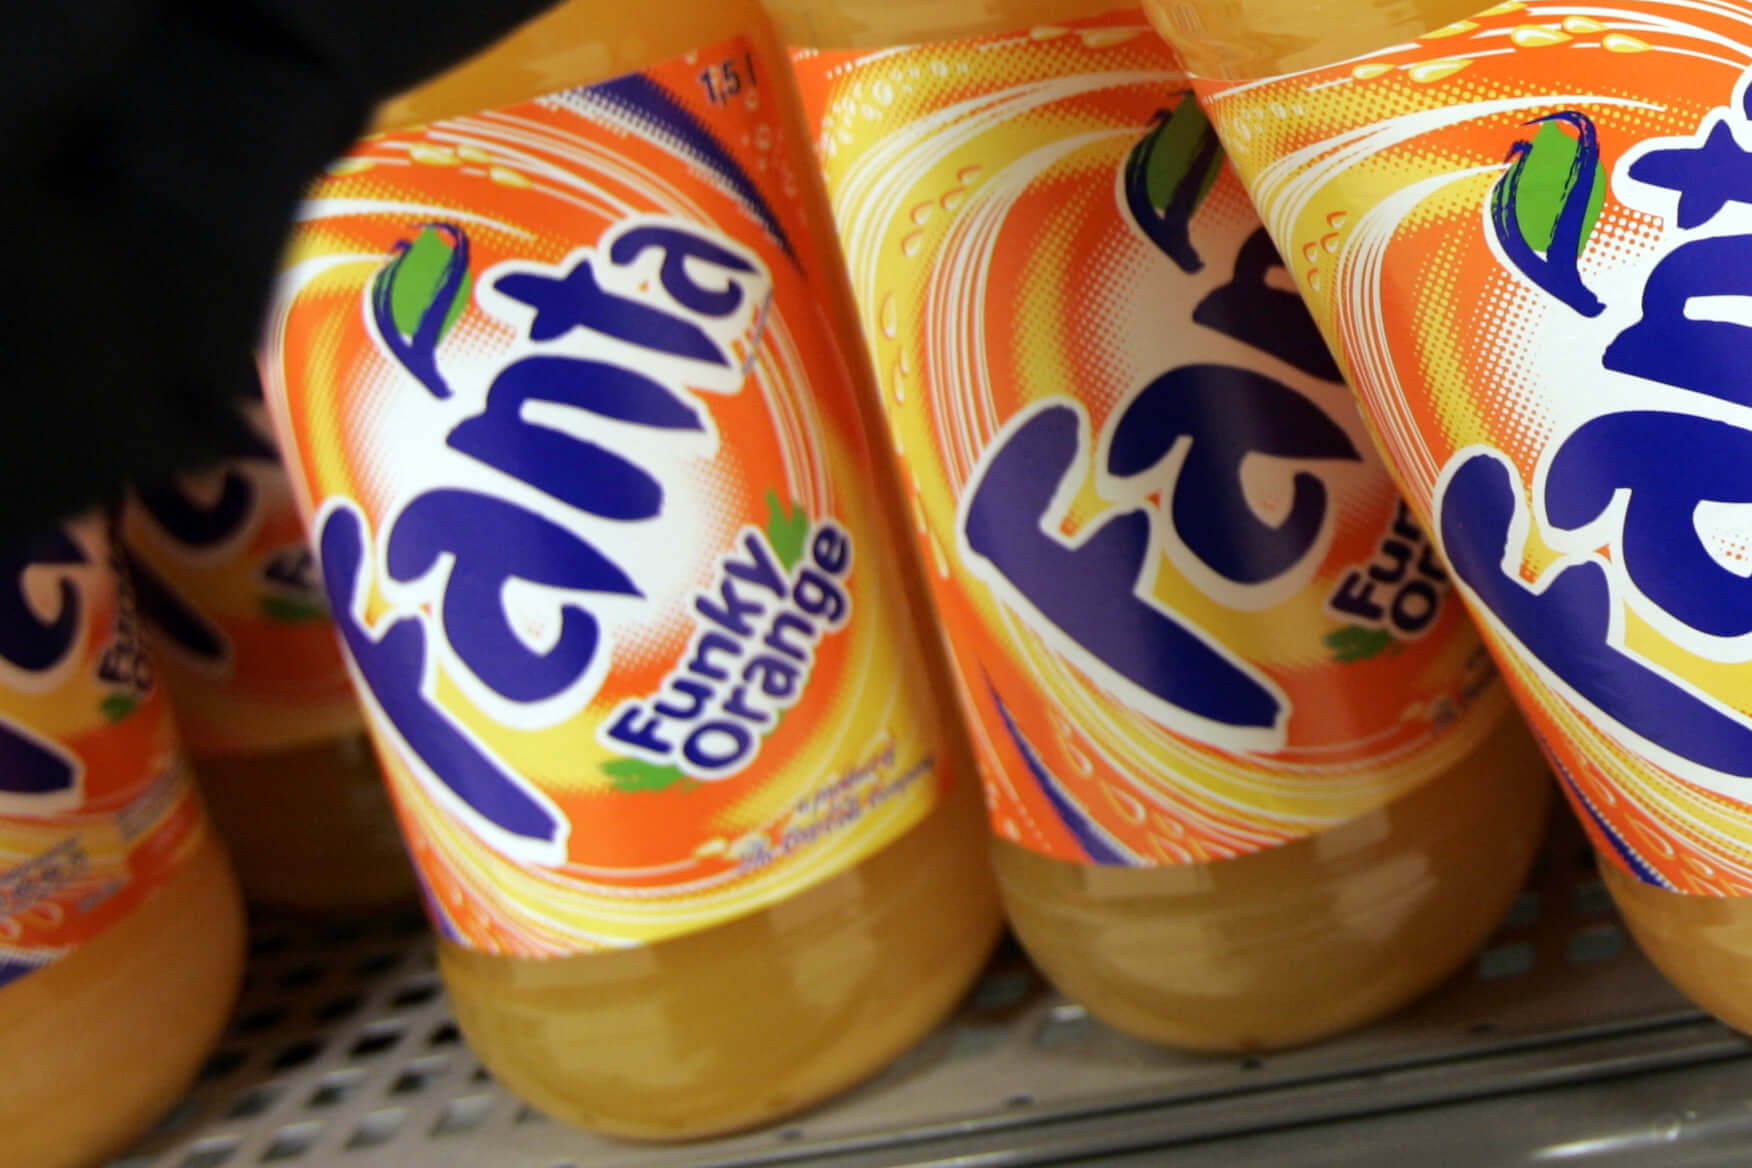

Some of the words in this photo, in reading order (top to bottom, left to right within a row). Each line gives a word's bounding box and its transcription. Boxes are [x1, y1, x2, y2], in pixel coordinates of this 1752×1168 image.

[319, 223, 758, 845] Fanta
[964, 227, 1365, 730] Fan
[1330, 496, 1422, 622] Fun
[606, 531, 790, 756] Funky
[682, 525, 849, 770] Orange
